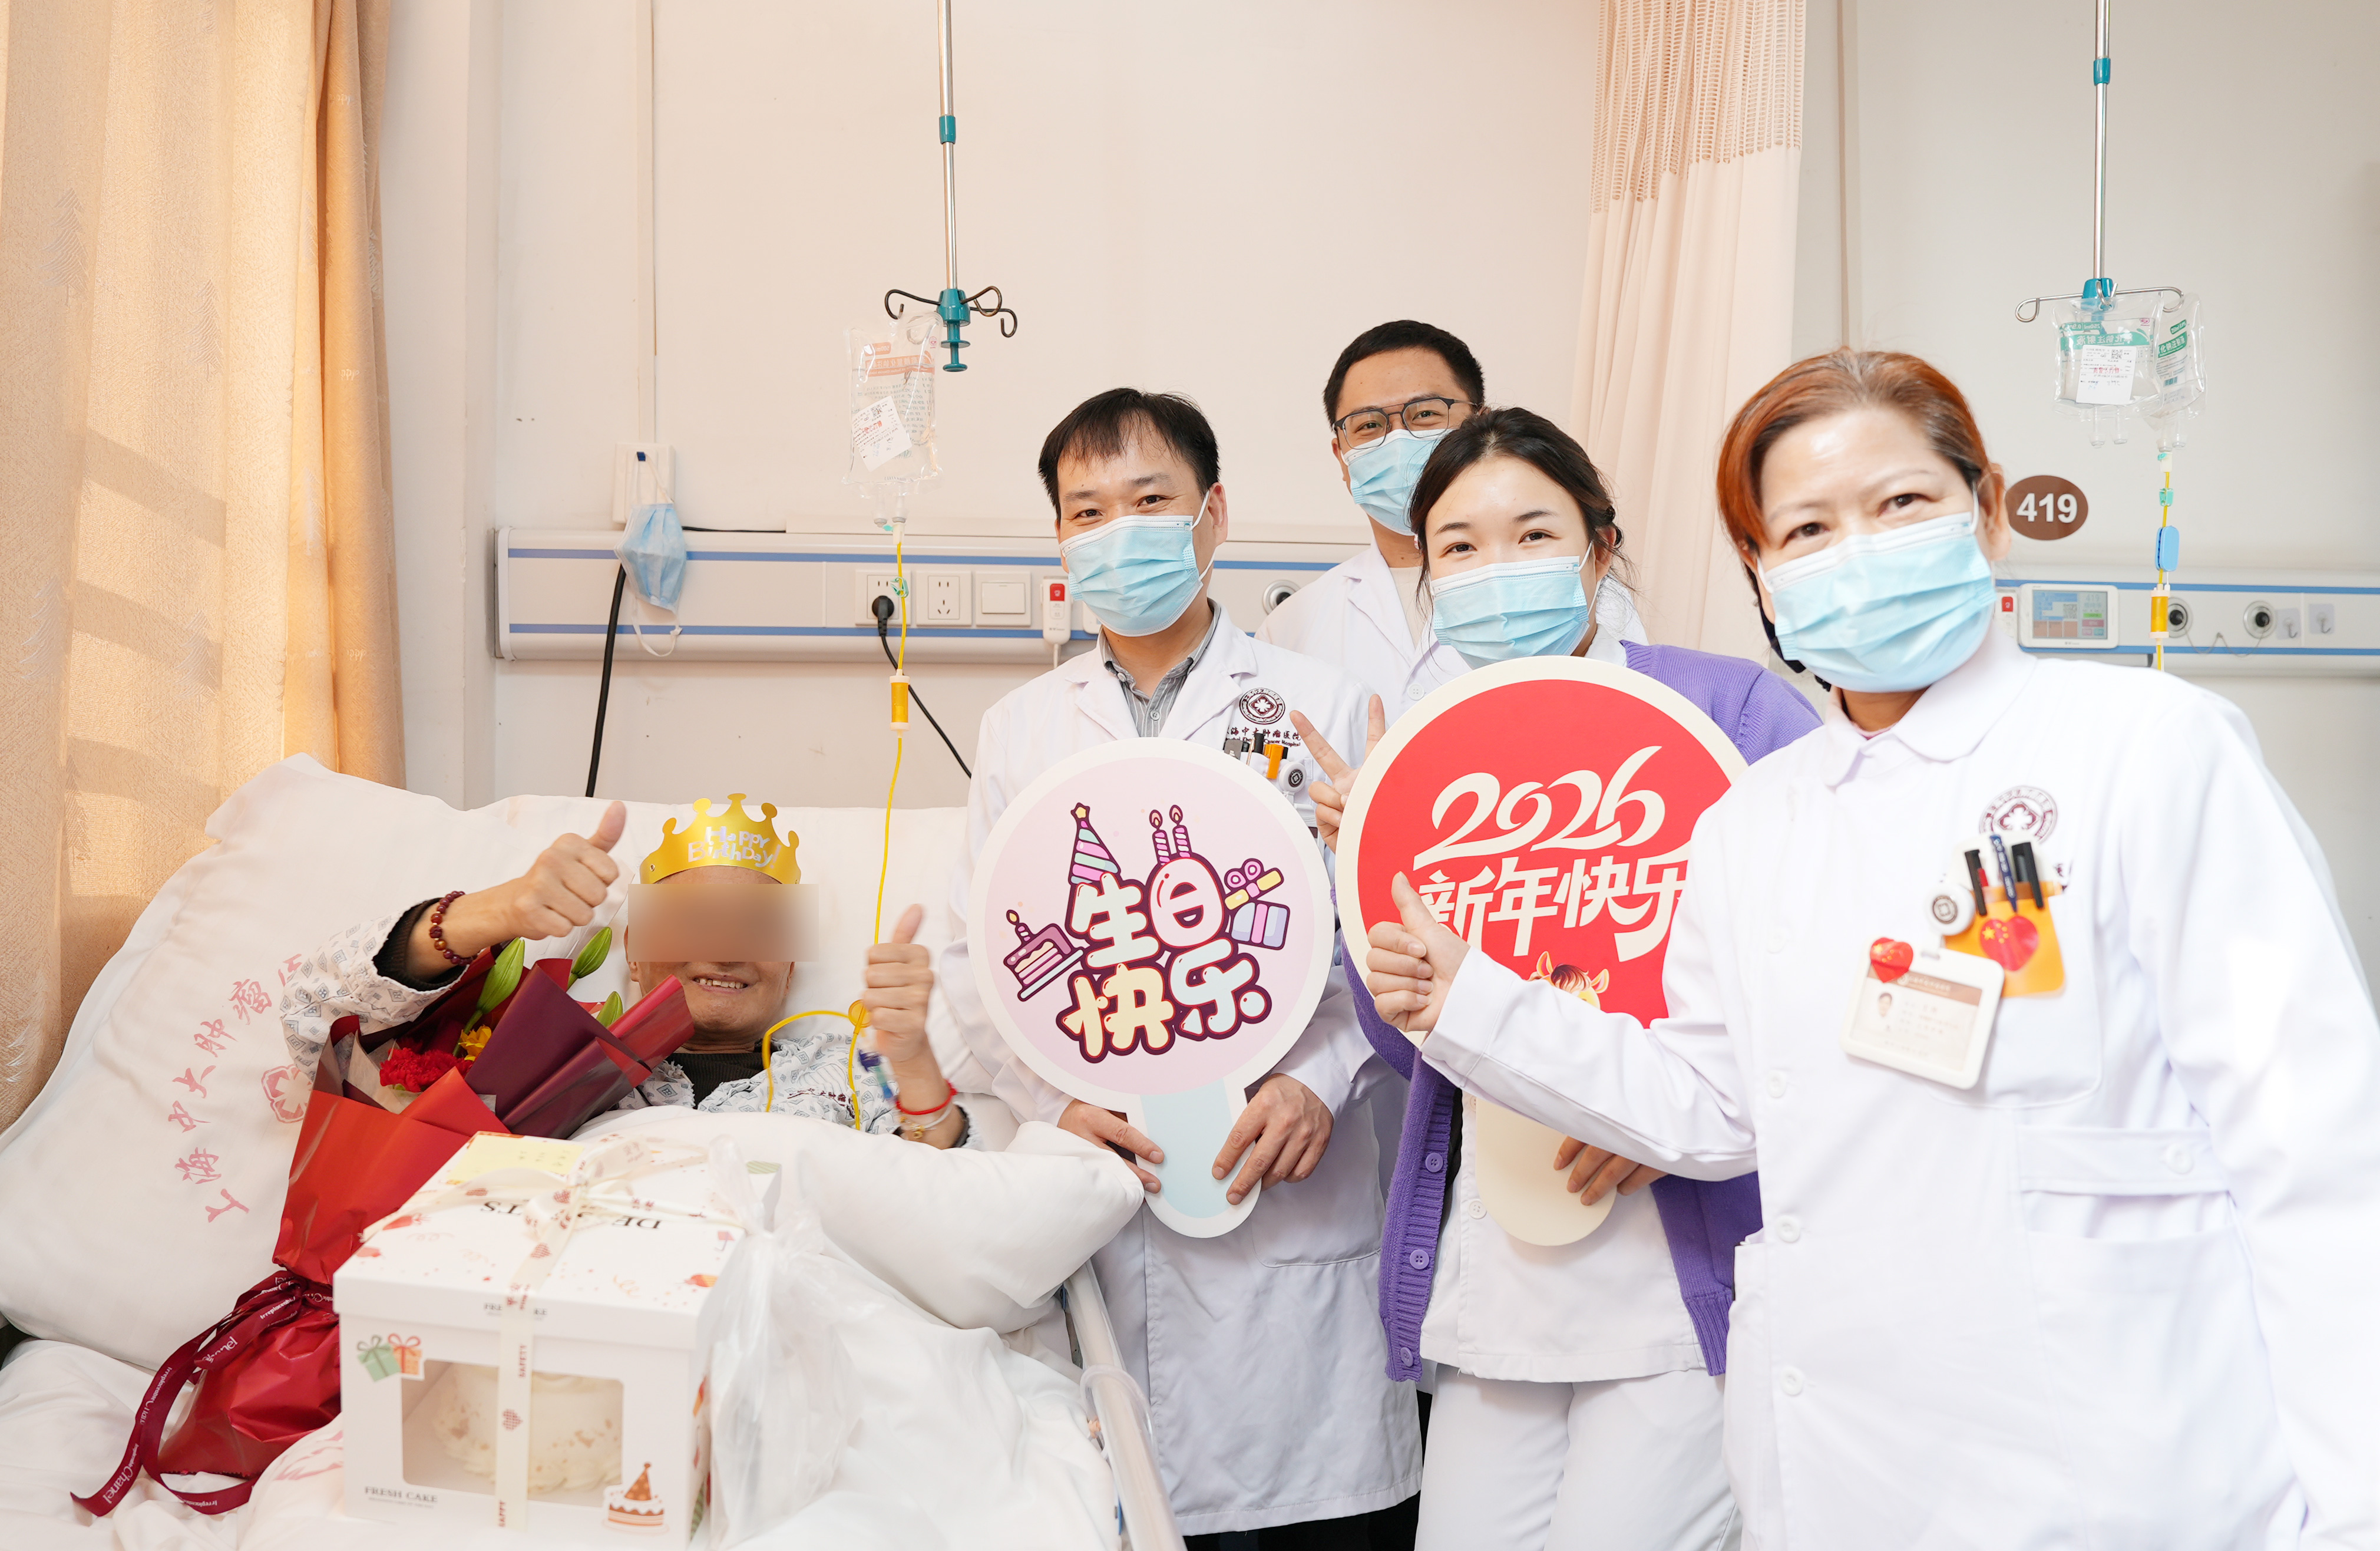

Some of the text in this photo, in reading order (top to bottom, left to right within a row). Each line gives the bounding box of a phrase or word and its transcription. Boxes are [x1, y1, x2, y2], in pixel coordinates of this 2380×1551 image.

[2157, 335, 2185, 354] 化钠注射液
[2016, 493, 2078, 523] 419
[1413, 745, 1666, 871] 2026
[1066, 854, 1227, 972] 生日
[1419, 839, 1691, 962] 新年快乐
[1058, 936, 1270, 1061] 快乐
[102, 1466, 134, 1504] Chanel
[364, 1486, 402, 1499] FRESH
[405, 1491, 438, 1503] CAKE
